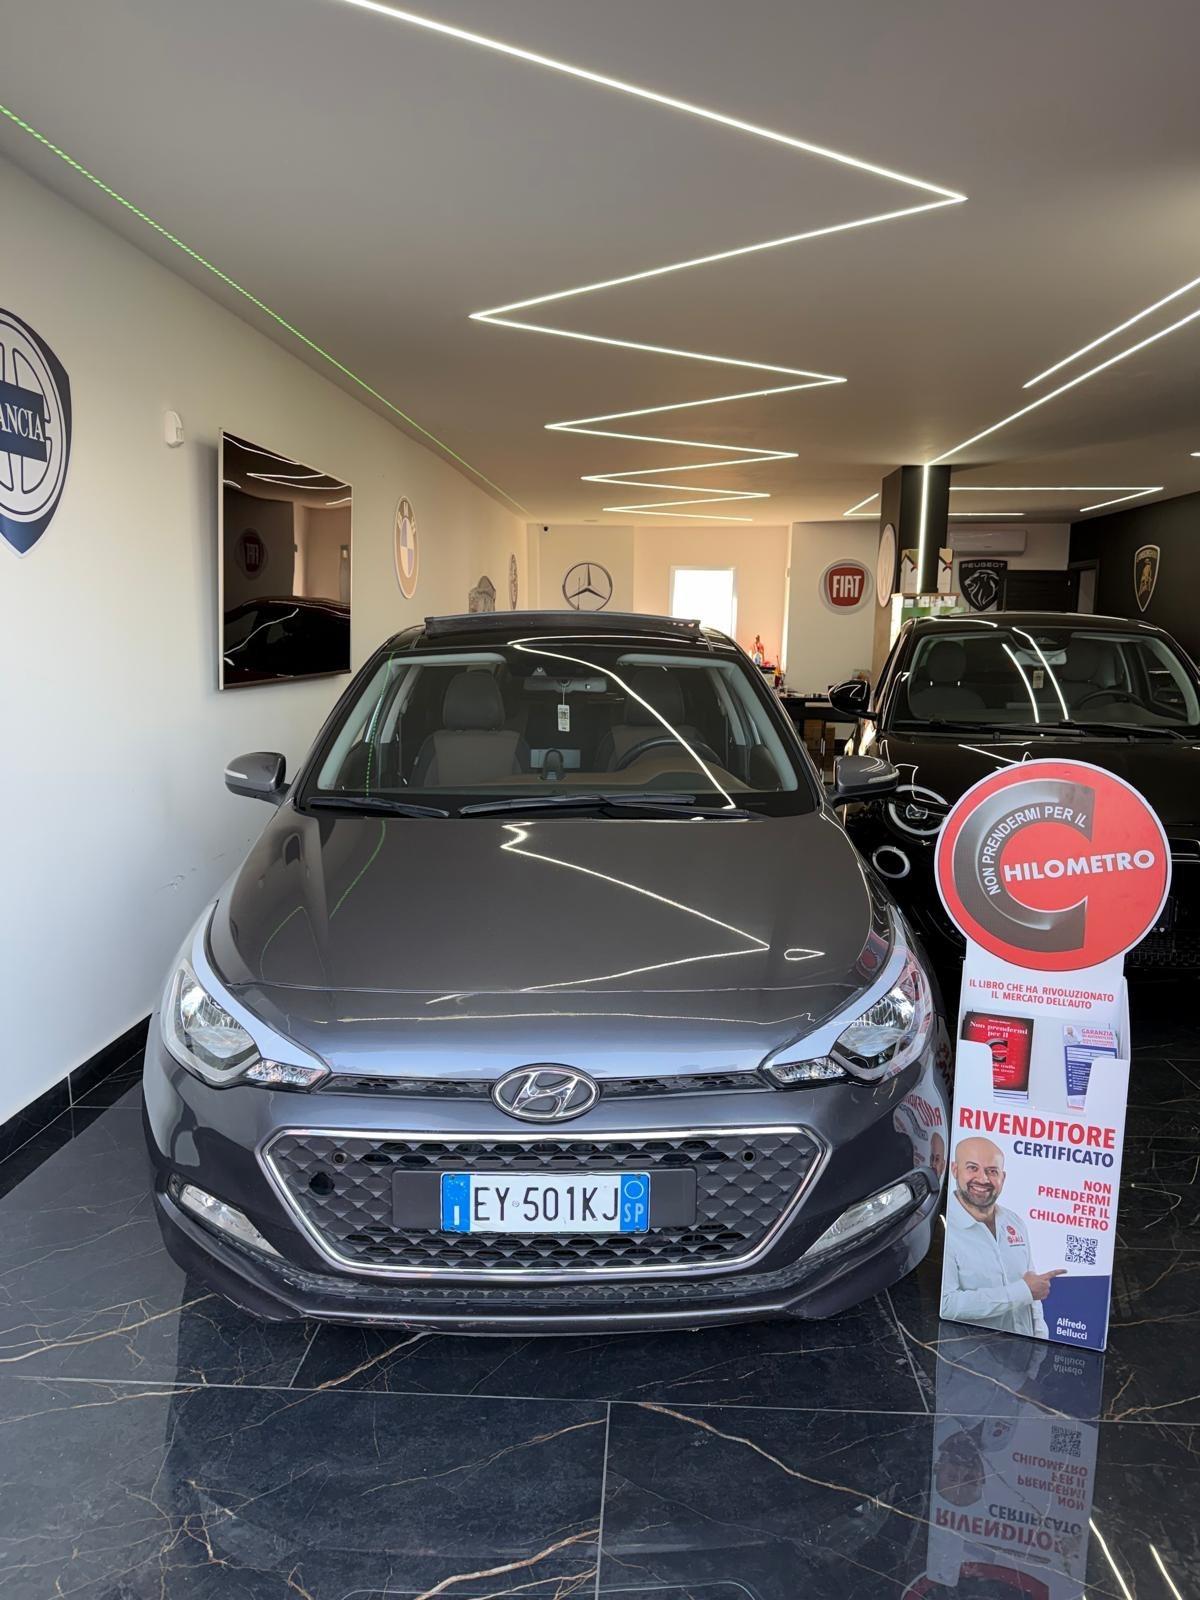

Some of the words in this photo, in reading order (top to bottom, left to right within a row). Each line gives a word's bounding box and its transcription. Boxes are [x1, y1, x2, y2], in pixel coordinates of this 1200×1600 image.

[0, 403, 45, 442] ANCIA
[832, 575, 862, 598] FIAT
[1044, 806, 1073, 821] PER
[1075, 813, 1088, 828] IL
[982, 806, 1041, 864] PRENDERMI
[982, 868, 1001, 895] NON
[969, 979, 977, 987] IL
[979, 980, 1004, 990] LIBRO
[1006, 982, 1023, 992] CHE
[1026, 985, 1038, 994] HA
[1042, 986, 1114, 1002] RIVOLUZIONATO
[991, 990, 999, 998] IL
[1002, 991, 1044, 1004] MERCATO
[1046, 996, 1092, 1009] DELL'AUTO
[959, 1107, 1116, 1149] RIVENDITORE
[1013, 1140, 1114, 1168] CERTIFICATO
[1038, 1185, 1111, 1206] PRENDERMI
[1084, 1180, 1112, 1194] NON
[474, 1187, 510, 1222] EY
[523, 1186, 619, 1222] 501KJ
[623, 1203, 645, 1223] SP
[1073, 1204, 1096, 1216] PER
[1100, 1208, 1110, 1219] IL
[1029, 1208, 1109, 1231] CHILOMETRO
[1056, 1317, 1087, 1331] Alfredo
[1056, 1326, 1088, 1340] Bellucci
